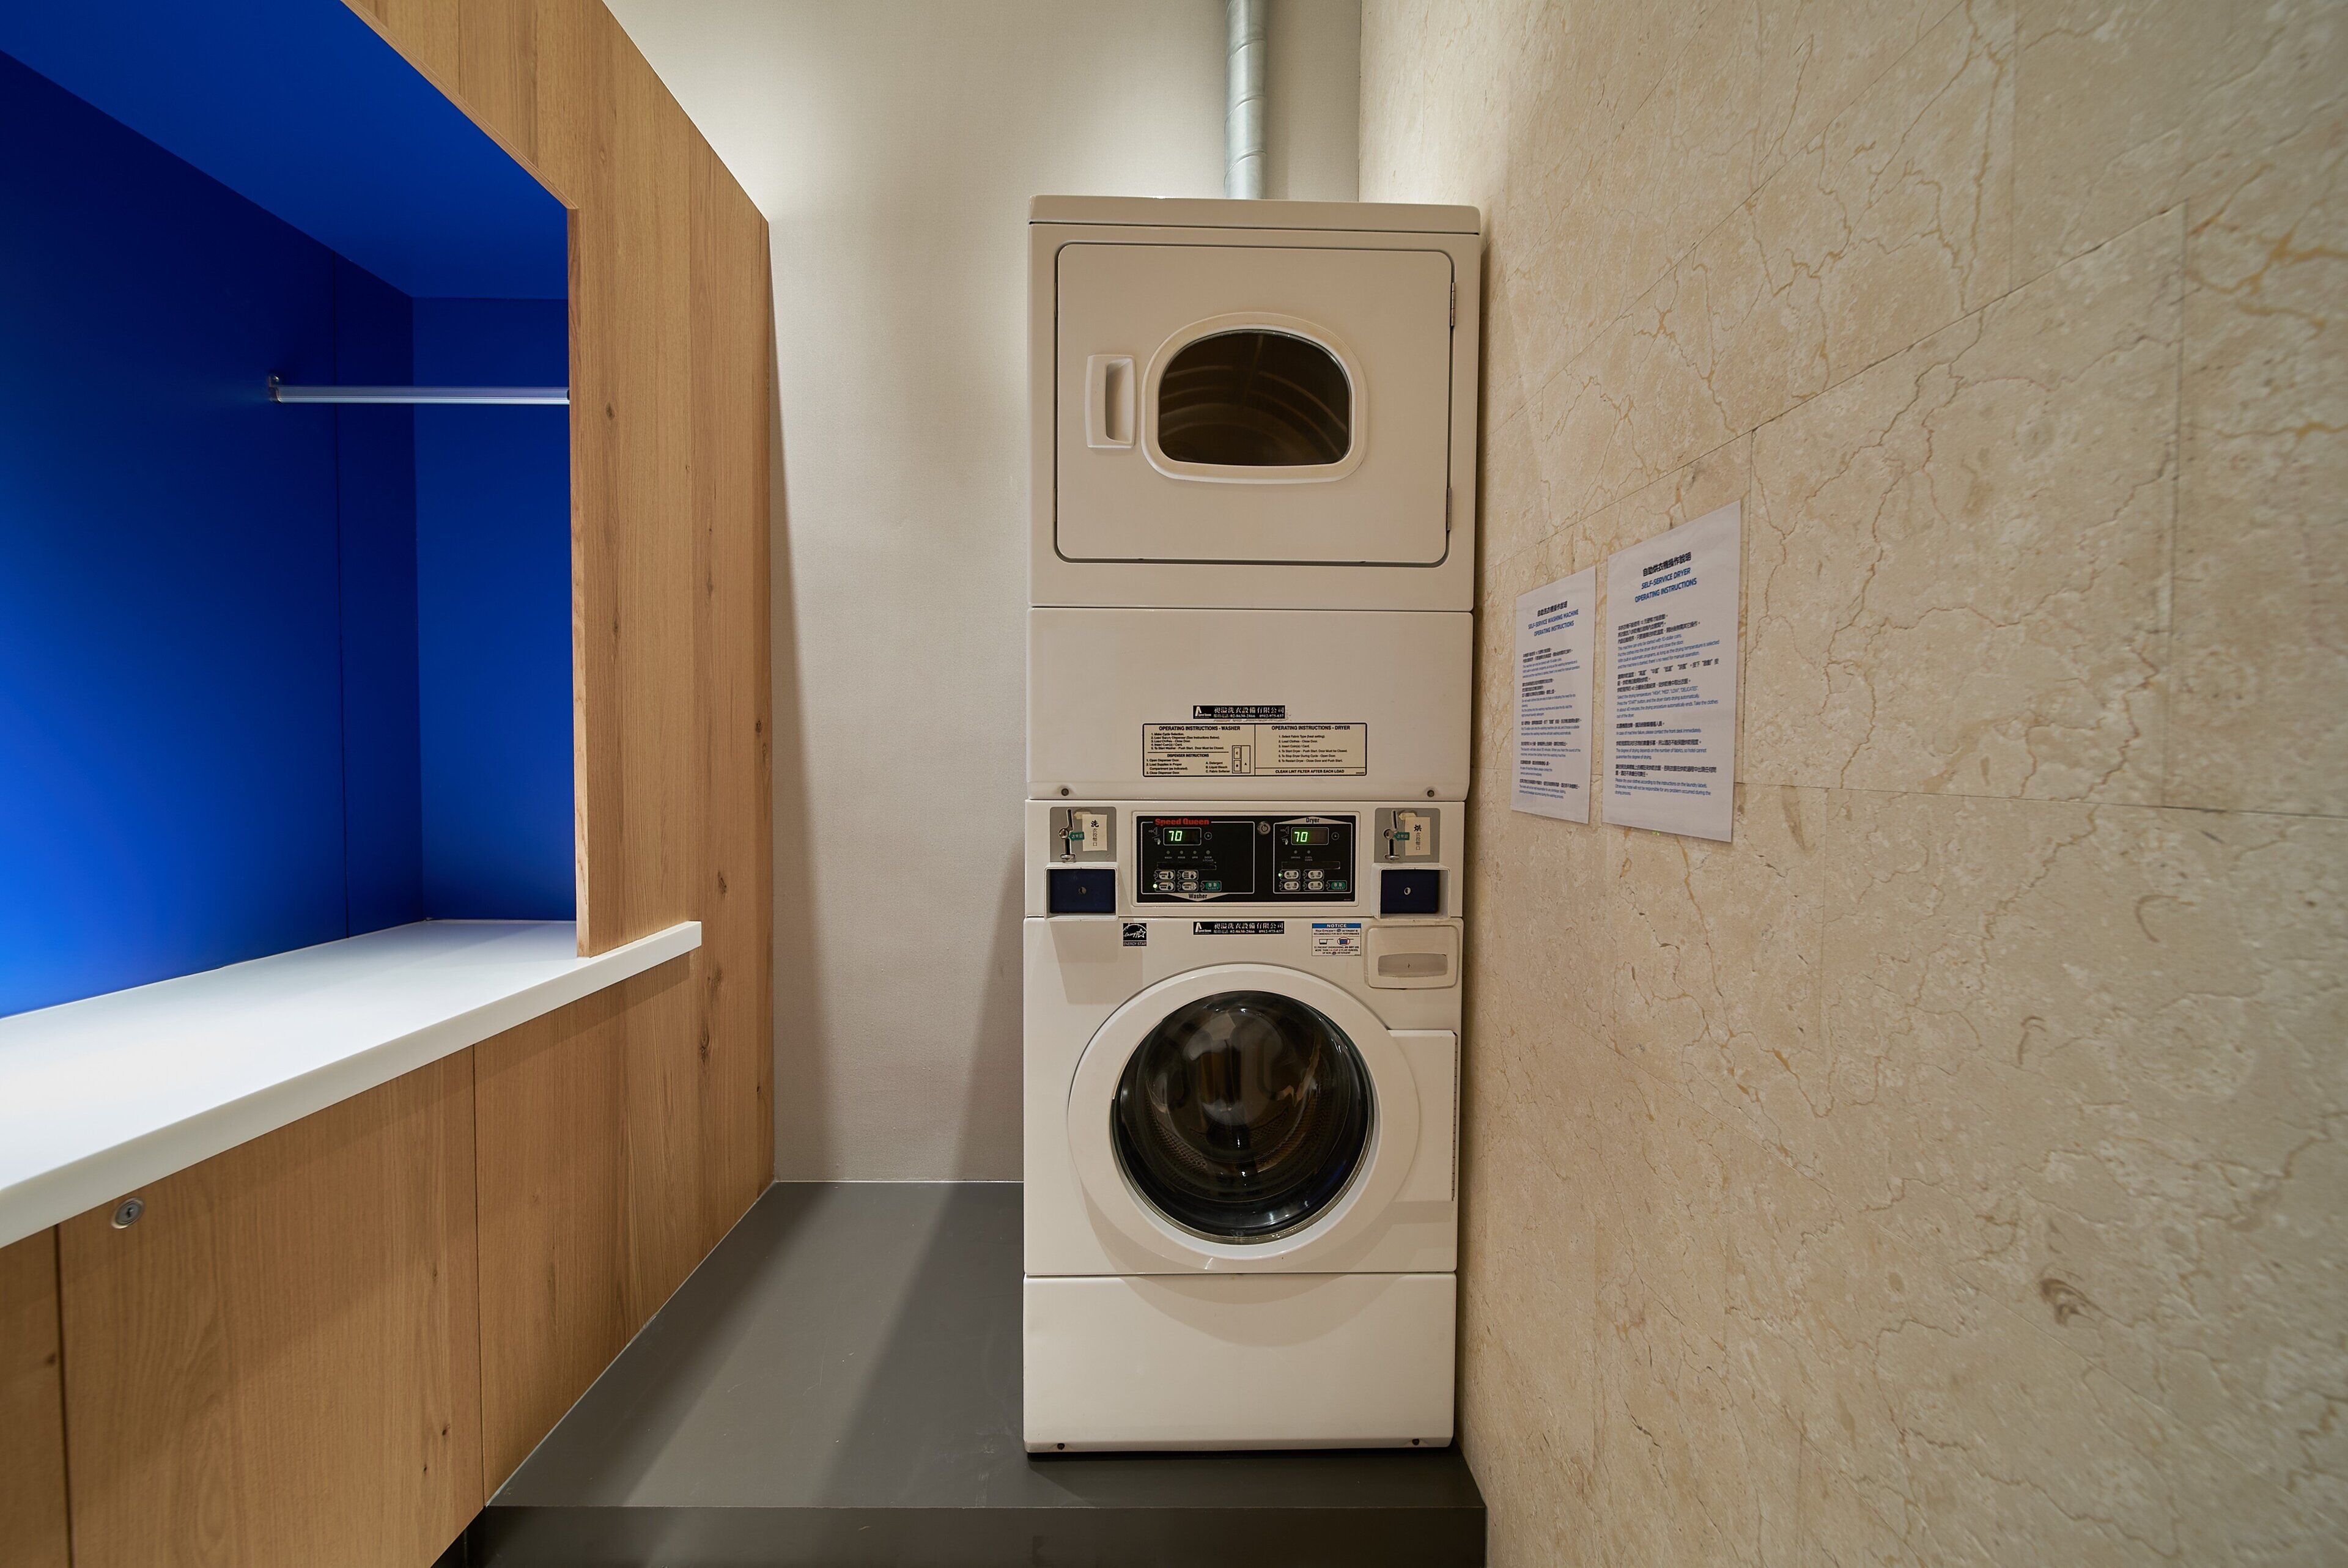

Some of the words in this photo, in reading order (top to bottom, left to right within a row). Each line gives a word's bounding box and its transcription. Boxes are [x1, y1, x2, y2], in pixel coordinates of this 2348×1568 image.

[1641, 573, 1672, 589] SELF-SERVICE
[1674, 567, 1690, 579] DRYER
[1634, 589, 1659, 603] OPERATING
[1661, 577, 1697, 595] INSTRUCTIONS
[1528, 619, 1547, 629] SELF-SERVICE
[1548, 614, 1563, 624] WASHING
[1563, 609, 1578, 619] MACHINE
[1534, 627, 1550, 636] OPERATING
[1551, 620, 1574, 631] INSTRUCTIONS
[1168, 831, 1183, 841] 70
[1294, 831, 1308, 842] 70
